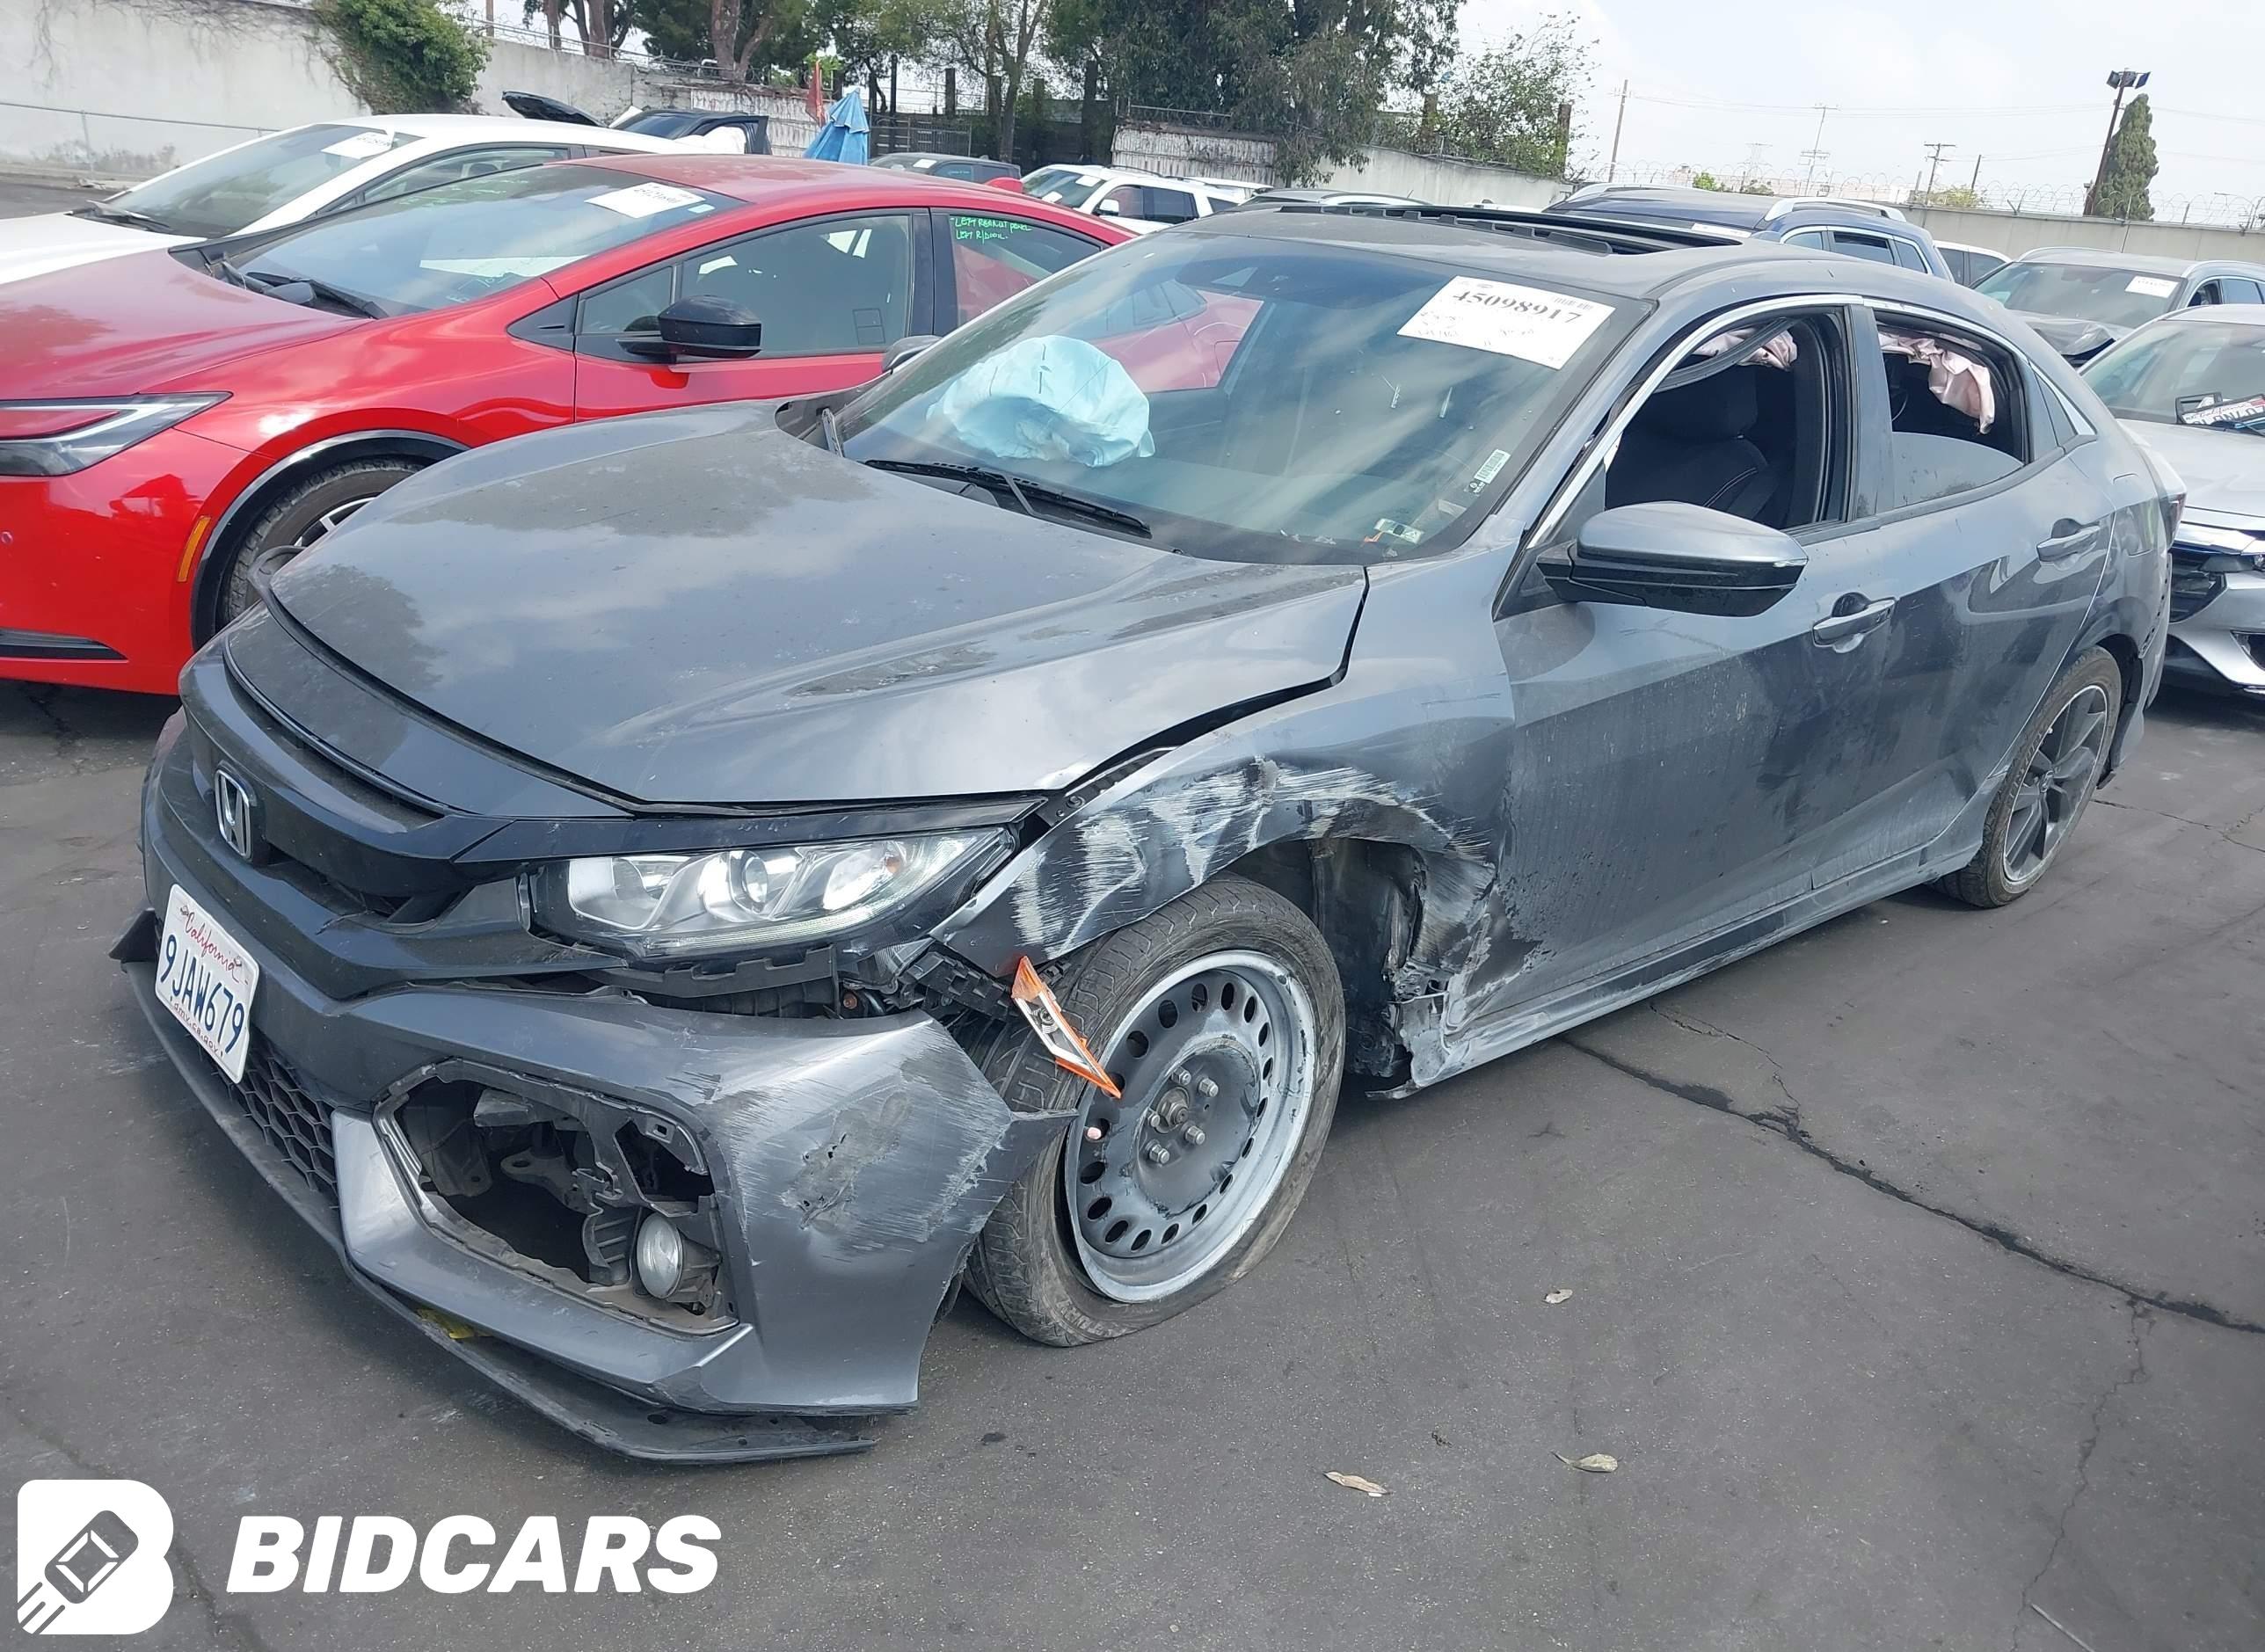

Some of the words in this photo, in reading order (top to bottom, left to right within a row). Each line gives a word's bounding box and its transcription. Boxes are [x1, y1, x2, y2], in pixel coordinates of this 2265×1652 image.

[1453, 290, 1583, 324] 45098917
[184, 911, 240, 984] California
[160, 934, 245, 1054] 9JAW679
